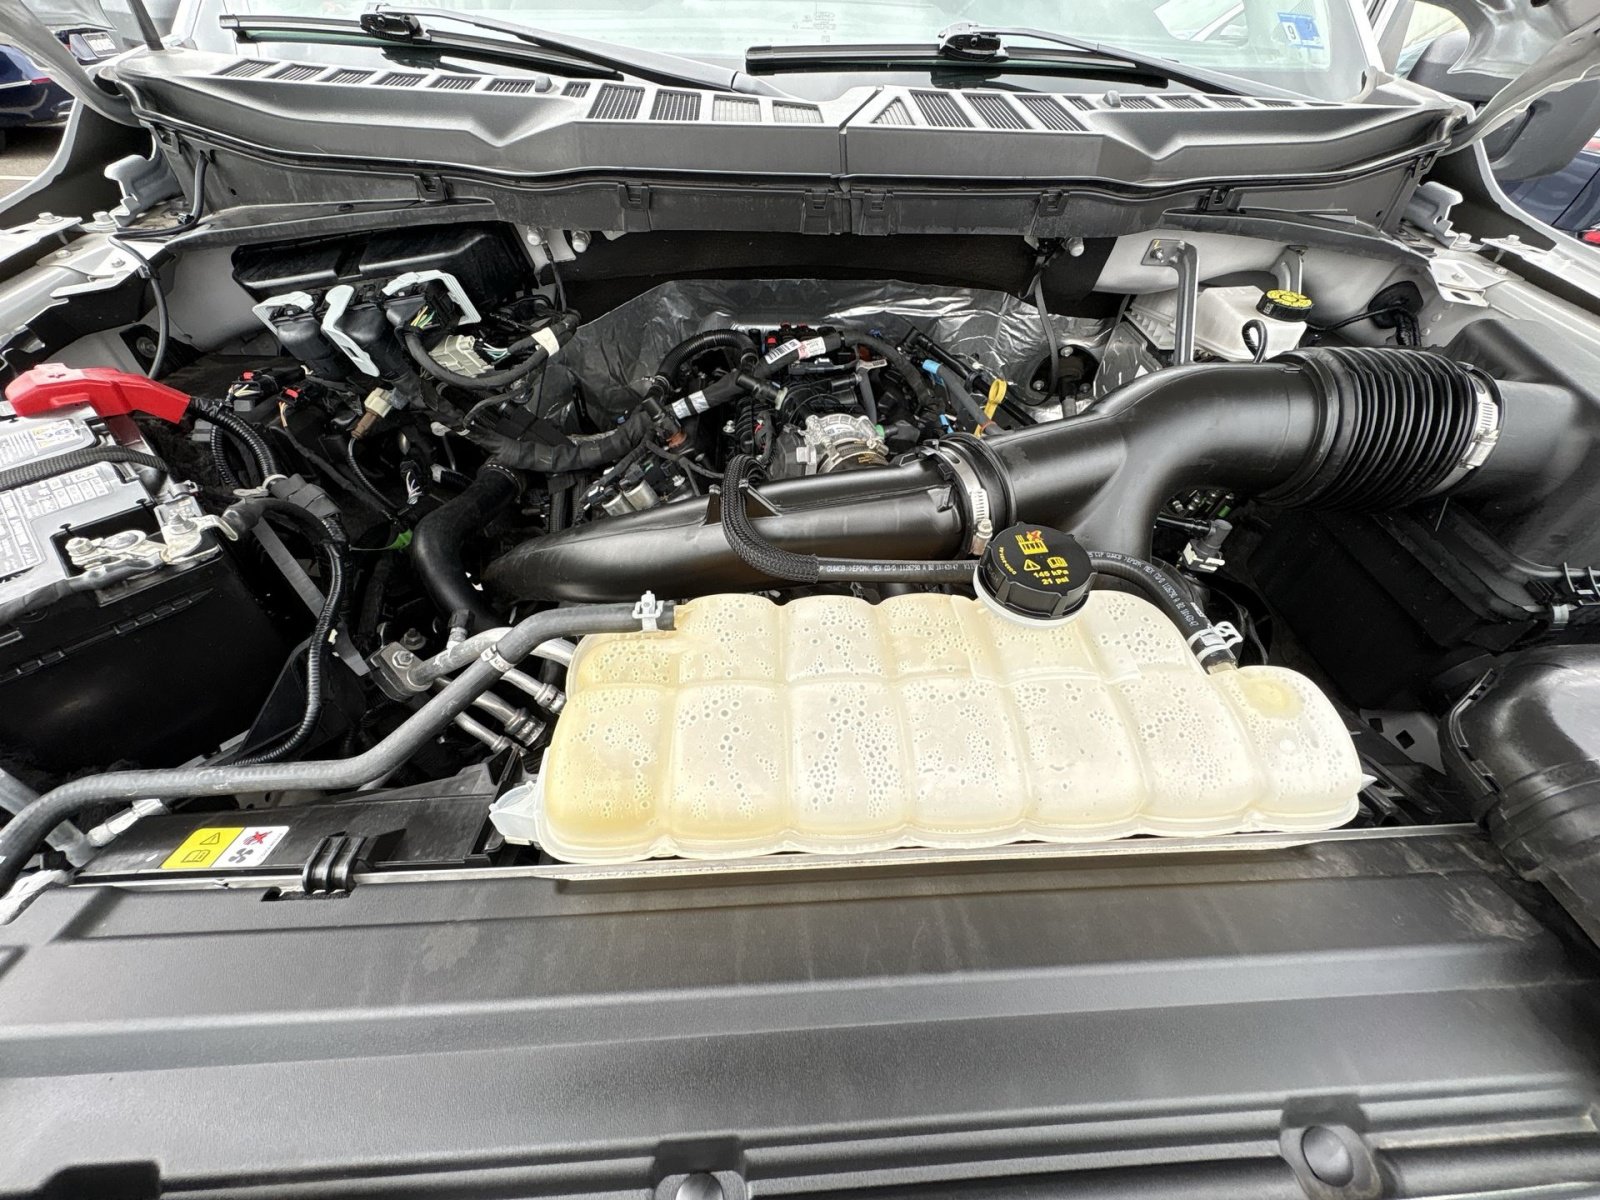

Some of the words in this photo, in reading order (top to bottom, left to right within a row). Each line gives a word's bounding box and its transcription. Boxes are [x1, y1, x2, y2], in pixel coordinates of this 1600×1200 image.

[1033, 570, 1051, 579] 145
[1051, 568, 1070, 577] kPa
[1041, 577, 1054, 586] 21
[1055, 576, 1070, 585] psi
